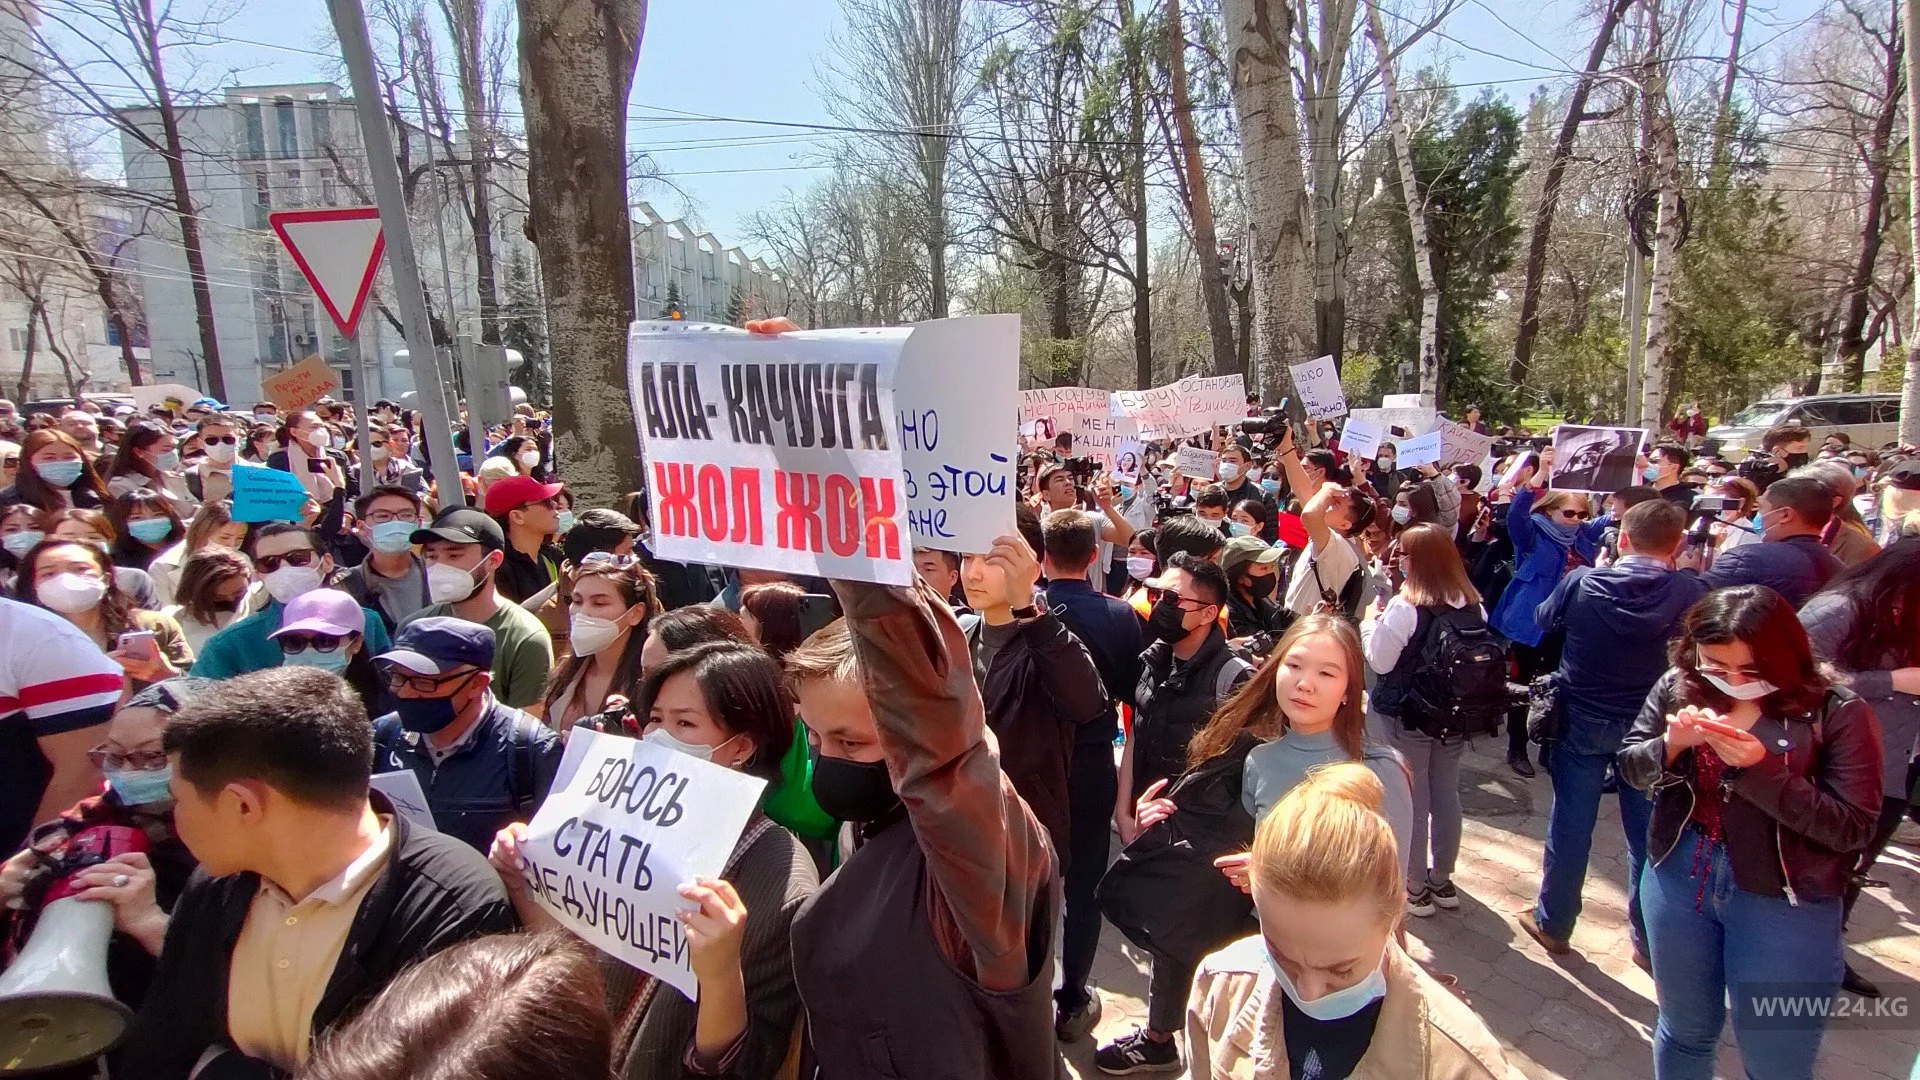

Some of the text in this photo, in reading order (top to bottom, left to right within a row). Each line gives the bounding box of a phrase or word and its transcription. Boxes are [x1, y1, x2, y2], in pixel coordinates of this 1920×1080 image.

[1024, 389, 1048, 404] АЛА
[1081, 417, 1116, 431] МЕН
[895, 408, 939, 452] НО
[653, 462, 901, 561] ЖОЛ ЖОК
[585, 758, 689, 827] БОЮСЬ
[553, 816, 653, 891] СТАТЬ
